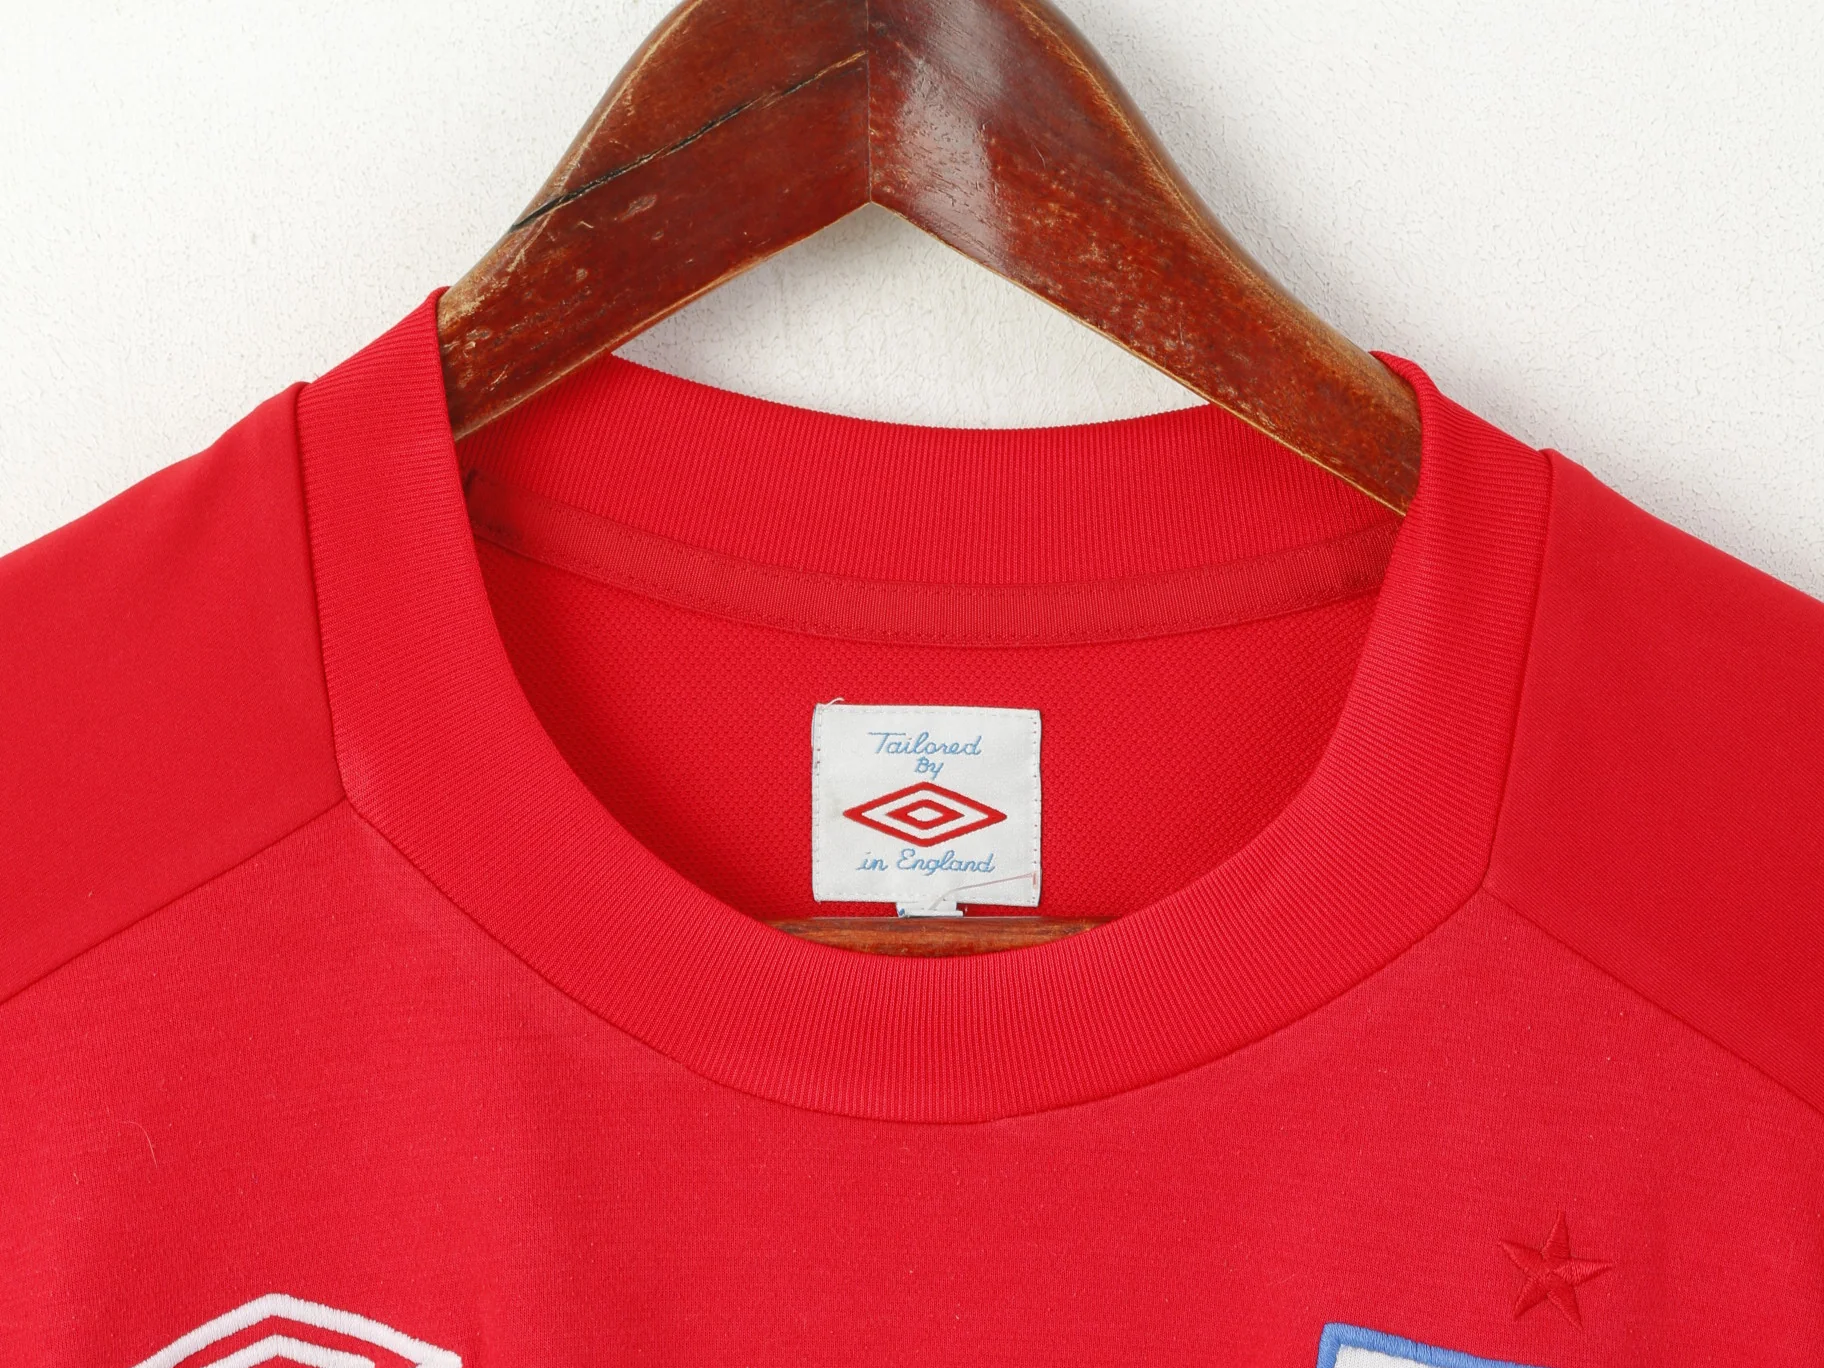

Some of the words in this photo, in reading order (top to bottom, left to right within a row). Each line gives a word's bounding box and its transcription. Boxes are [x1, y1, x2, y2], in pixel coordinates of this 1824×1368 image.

[868, 731, 982, 756] Tailored
[914, 756, 944, 780] By
[856, 851, 888, 871] in
[896, 848, 996, 877] England
